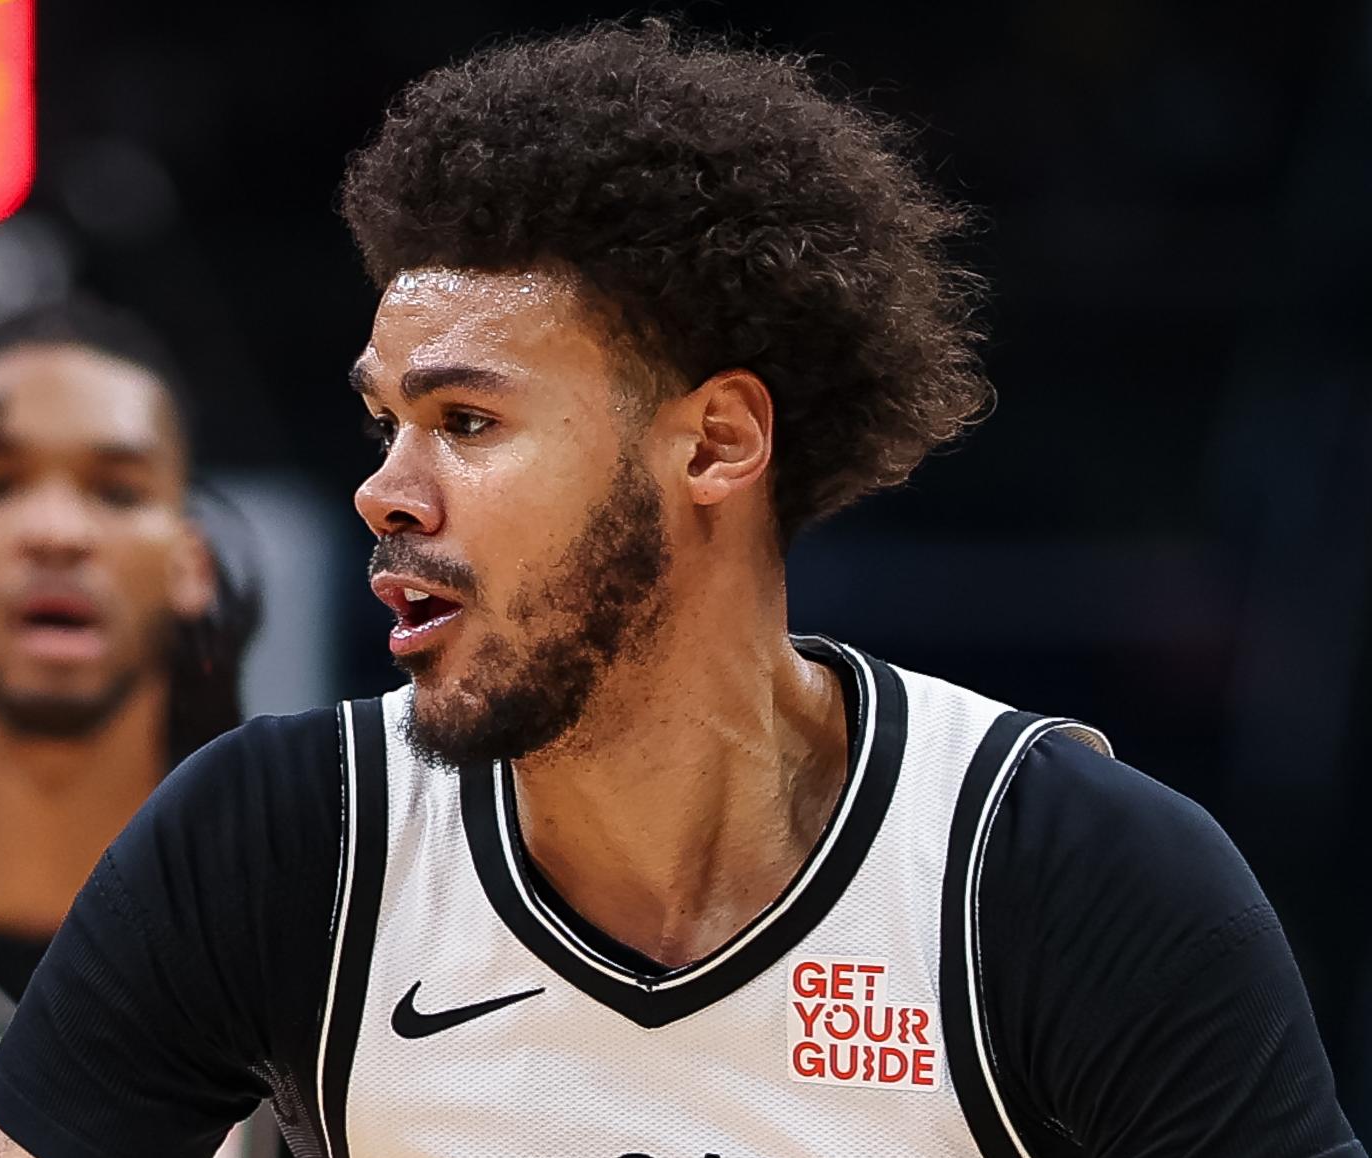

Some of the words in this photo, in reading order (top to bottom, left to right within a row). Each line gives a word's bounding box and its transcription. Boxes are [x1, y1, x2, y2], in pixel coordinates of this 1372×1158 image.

[793, 961, 884, 1001] GET
[793, 1001, 929, 1045] YOUR
[793, 1041, 935, 1086] GUIDE
